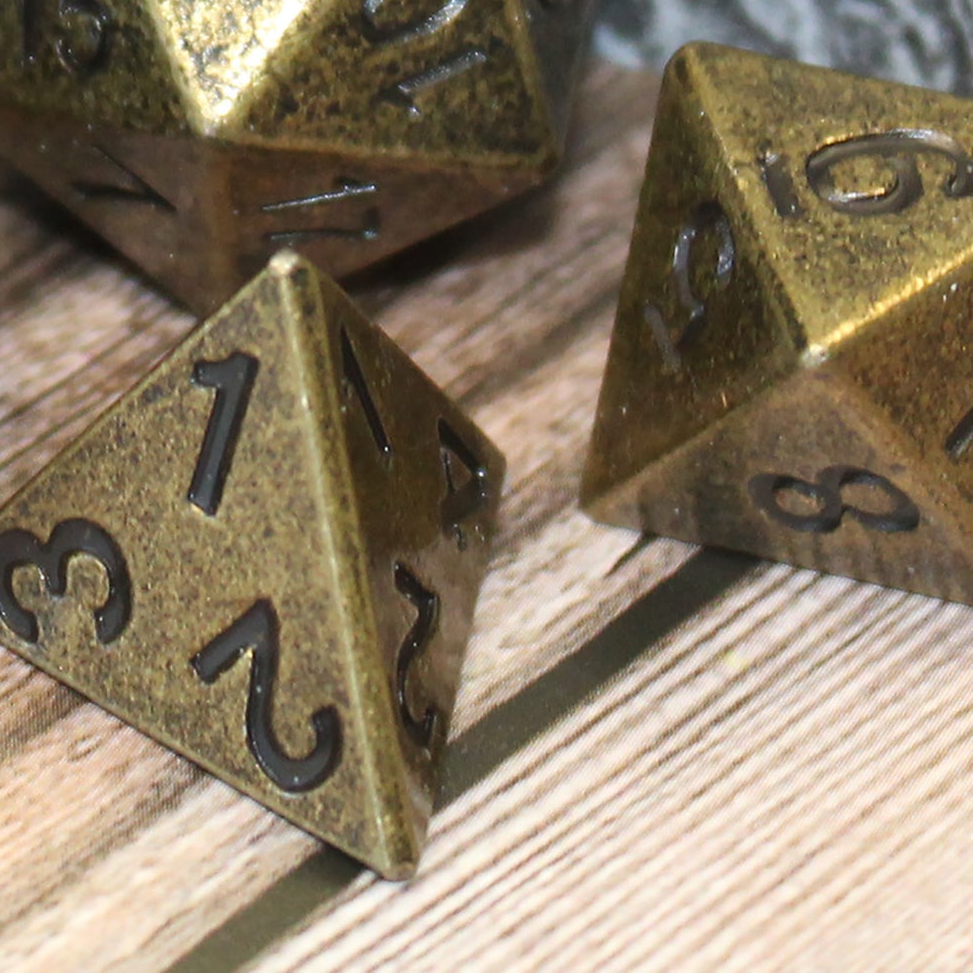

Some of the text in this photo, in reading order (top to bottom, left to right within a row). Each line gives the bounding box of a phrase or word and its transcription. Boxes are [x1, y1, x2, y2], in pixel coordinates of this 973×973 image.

[187, 349, 261, 517] 1
[746, 463, 921, 534] 8
[189, 597, 344, 794] 2
